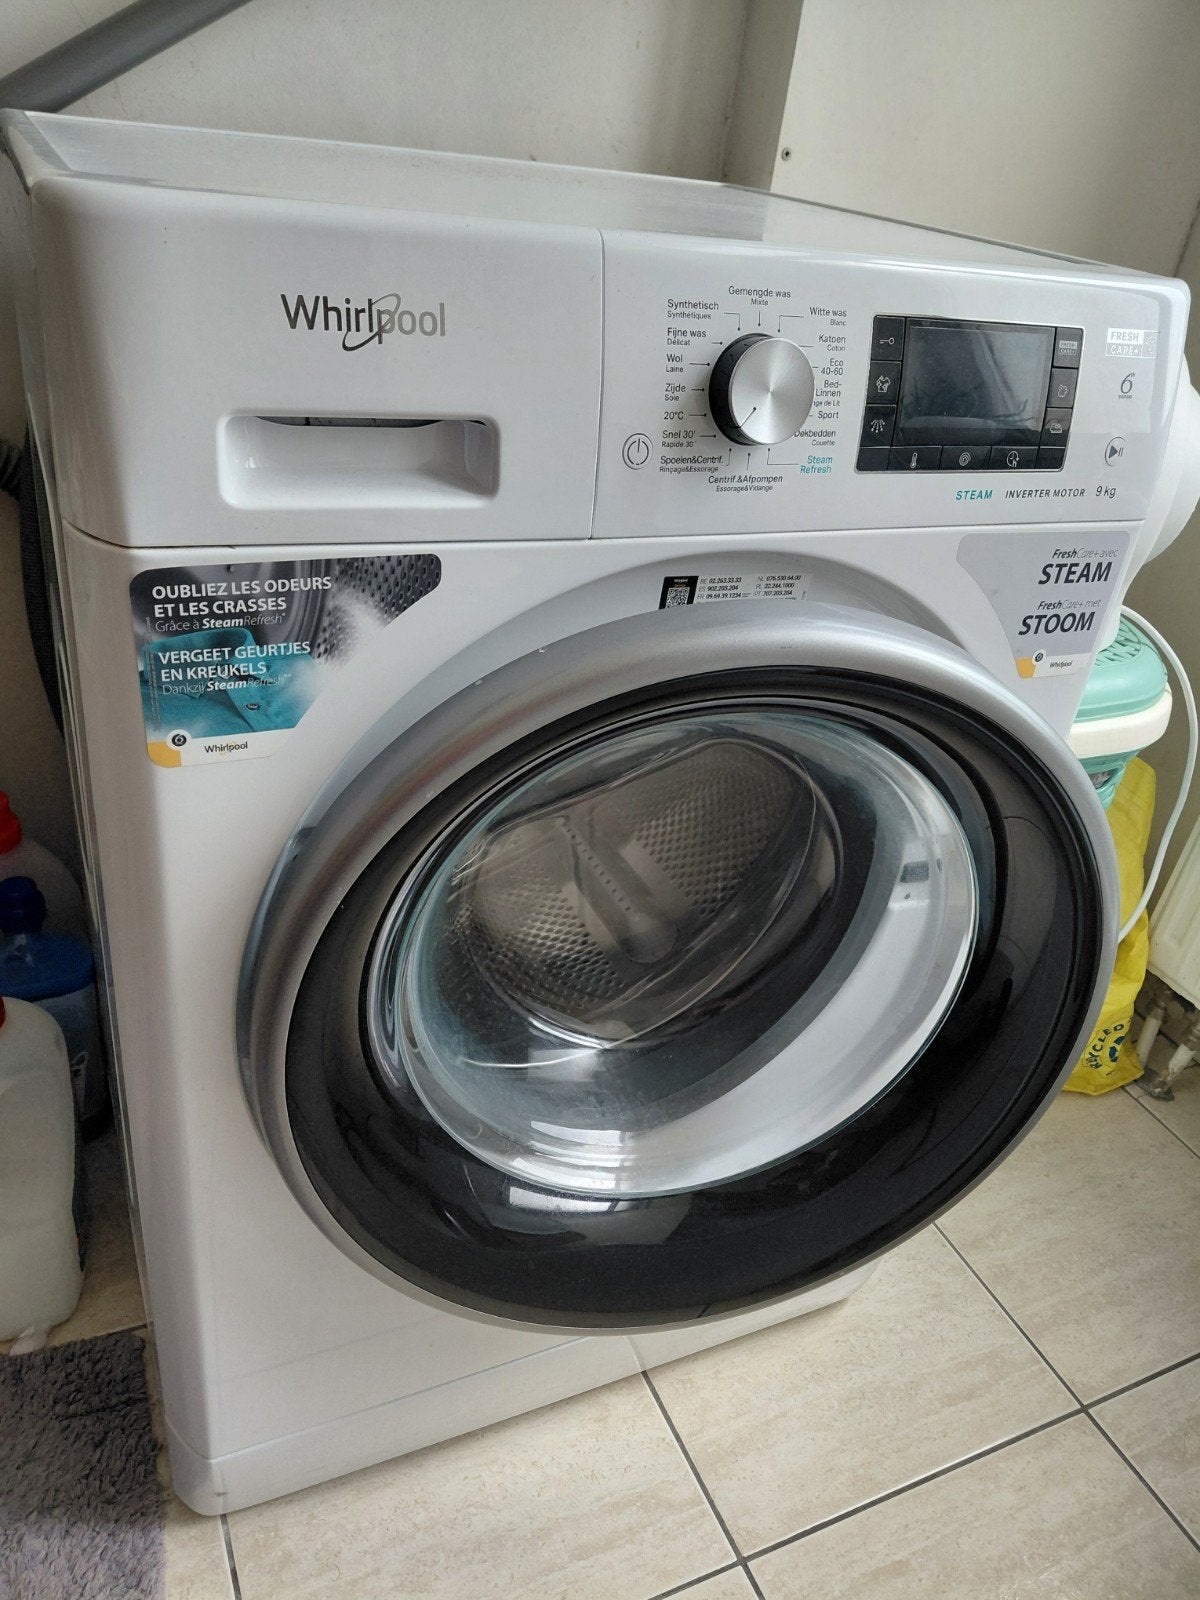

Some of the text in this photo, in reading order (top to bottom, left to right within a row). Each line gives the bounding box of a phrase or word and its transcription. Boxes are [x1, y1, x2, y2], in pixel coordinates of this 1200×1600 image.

[728, 286, 791, 298] Gemengde was
[667, 299, 719, 310] Synthetisch
[751, 298, 768, 306] Mixte
[667, 311, 712, 320] Synthétiques
[810, 307, 831, 316] Witte
[280, 293, 446, 351] Whirlpool
[667, 328, 707, 338] Fijne was
[1110, 331, 1140, 342] FRESH
[667, 338, 690, 346] Délicat
[819, 334, 846, 344] Katoen
[1110, 345, 1138, 355] CARE+
[667, 354, 683, 362] Wol
[830, 358, 844, 366] Eco
[666, 365, 683, 373] Laine
[821, 367, 844, 376] 40-60
[665, 383, 686, 394] Zijde
[824, 380, 842, 388] Bed-
[815, 388, 841, 397] Linnen
[665, 394, 680, 402] Soie
[664, 411, 684, 420] 20°C
[818, 411, 839, 420] Sport
[662, 430, 681, 438] Snel
[794, 429, 836, 438] Dekbedden
[662, 441, 683, 449] Rapide
[660, 456, 723, 465] Spoelen&Centrif.
[807, 455, 833, 464] Steam
[660, 466, 719, 474] Rinçage&Essorage
[800, 465, 832, 474] Refresh
[708, 476, 783, 485] Centrif.&Afpompen
[716, 485, 773, 493] Essorage&Vidange
[1005, 488, 1086, 499] INVERTER MOTOR
[956, 490, 993, 500] STEAM
[1052, 548, 1119, 559] FreshCare+ avec
[1038, 562, 1113, 584] STEAM
[152, 577, 332, 600] OUBLIEZ LES ODEURS
[154, 597, 287, 617] ET LES CRASSES
[1037, 600, 1101, 610] FreshCare+ met
[155, 617, 191, 632] Grâce
[193, 619, 200, 630] à
[1018, 612, 1096, 636] STOOM
[158, 641, 311, 665] VERGEET GEURTJES
[161, 662, 267, 682] EN KREUKELS
[162, 681, 206, 697] Dankzij
[204, 741, 248, 754] Whirlpool
